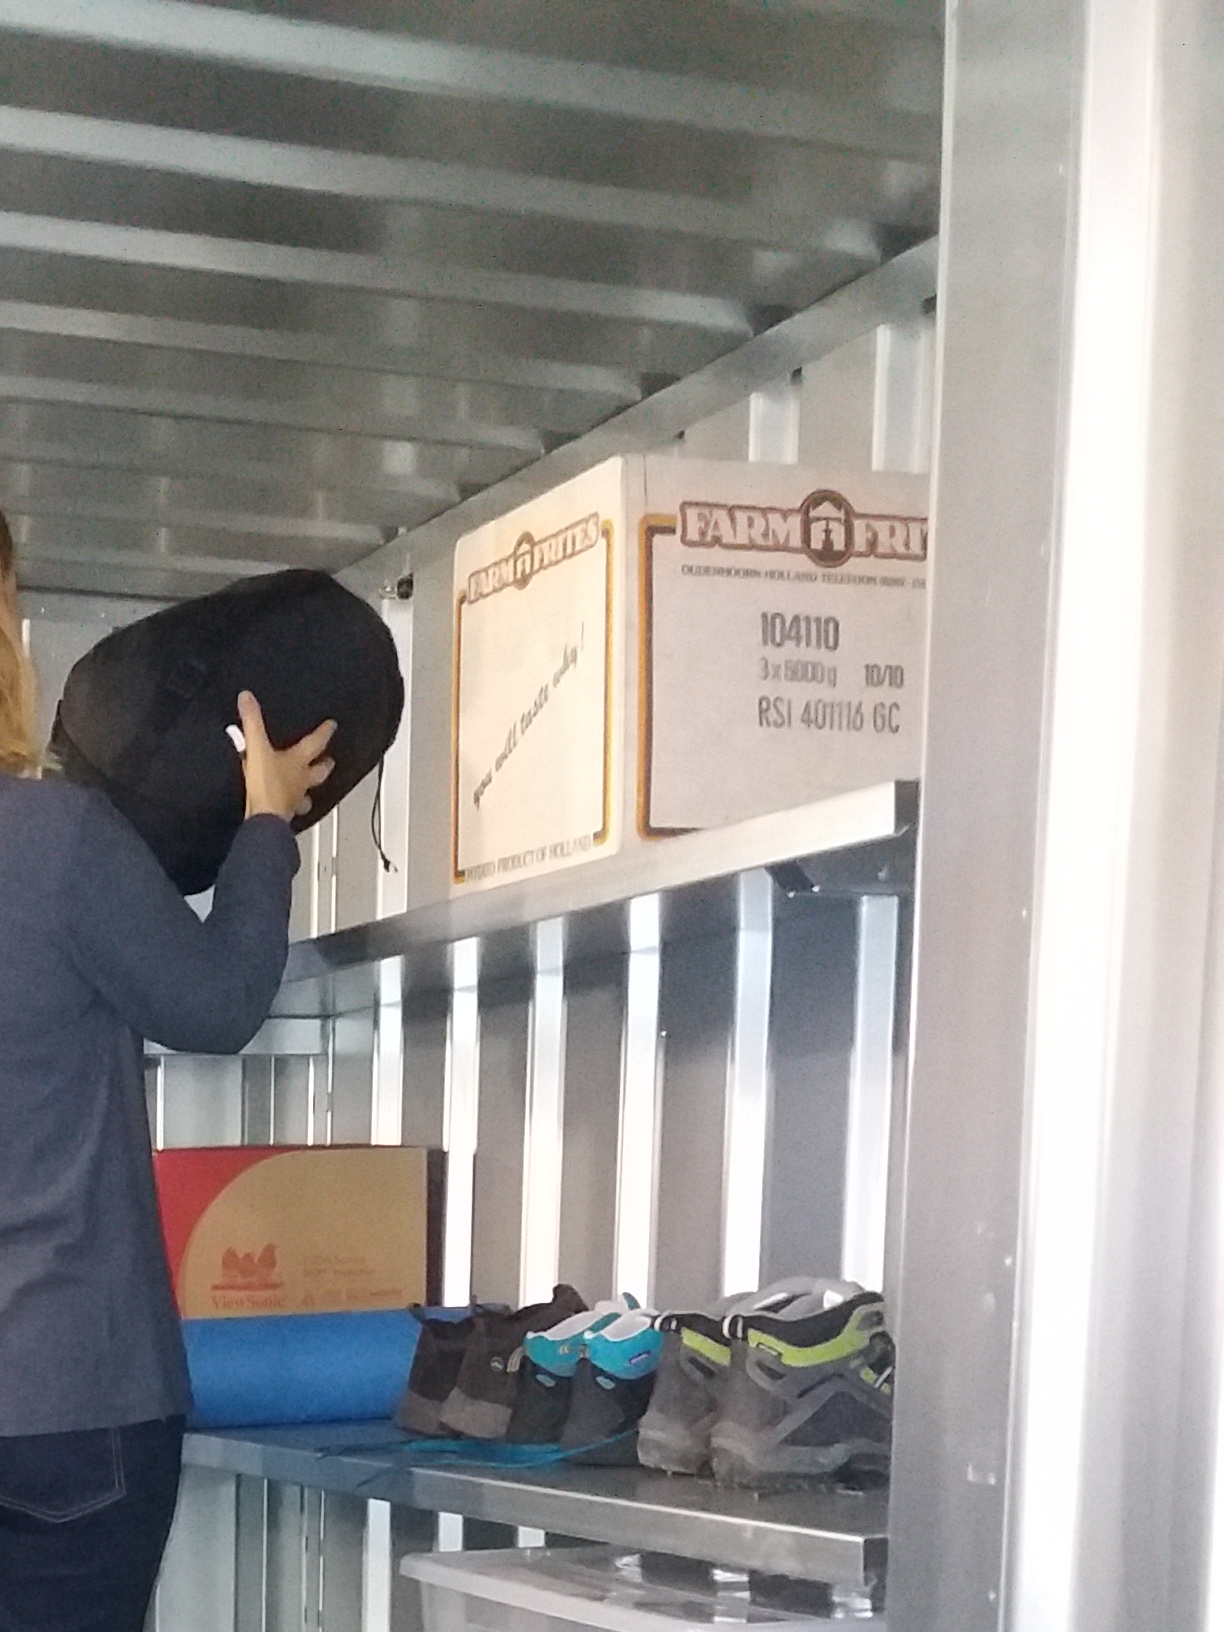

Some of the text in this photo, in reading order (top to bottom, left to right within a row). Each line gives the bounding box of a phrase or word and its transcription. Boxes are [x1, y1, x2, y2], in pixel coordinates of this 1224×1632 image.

[681, 503, 802, 552] FARM
[468, 512, 599, 603] FARM FRITES
[760, 611, 840, 651] 104110
[865, 663, 905, 690] 10/10
[758, 694, 902, 733] RSI 401116 GC
